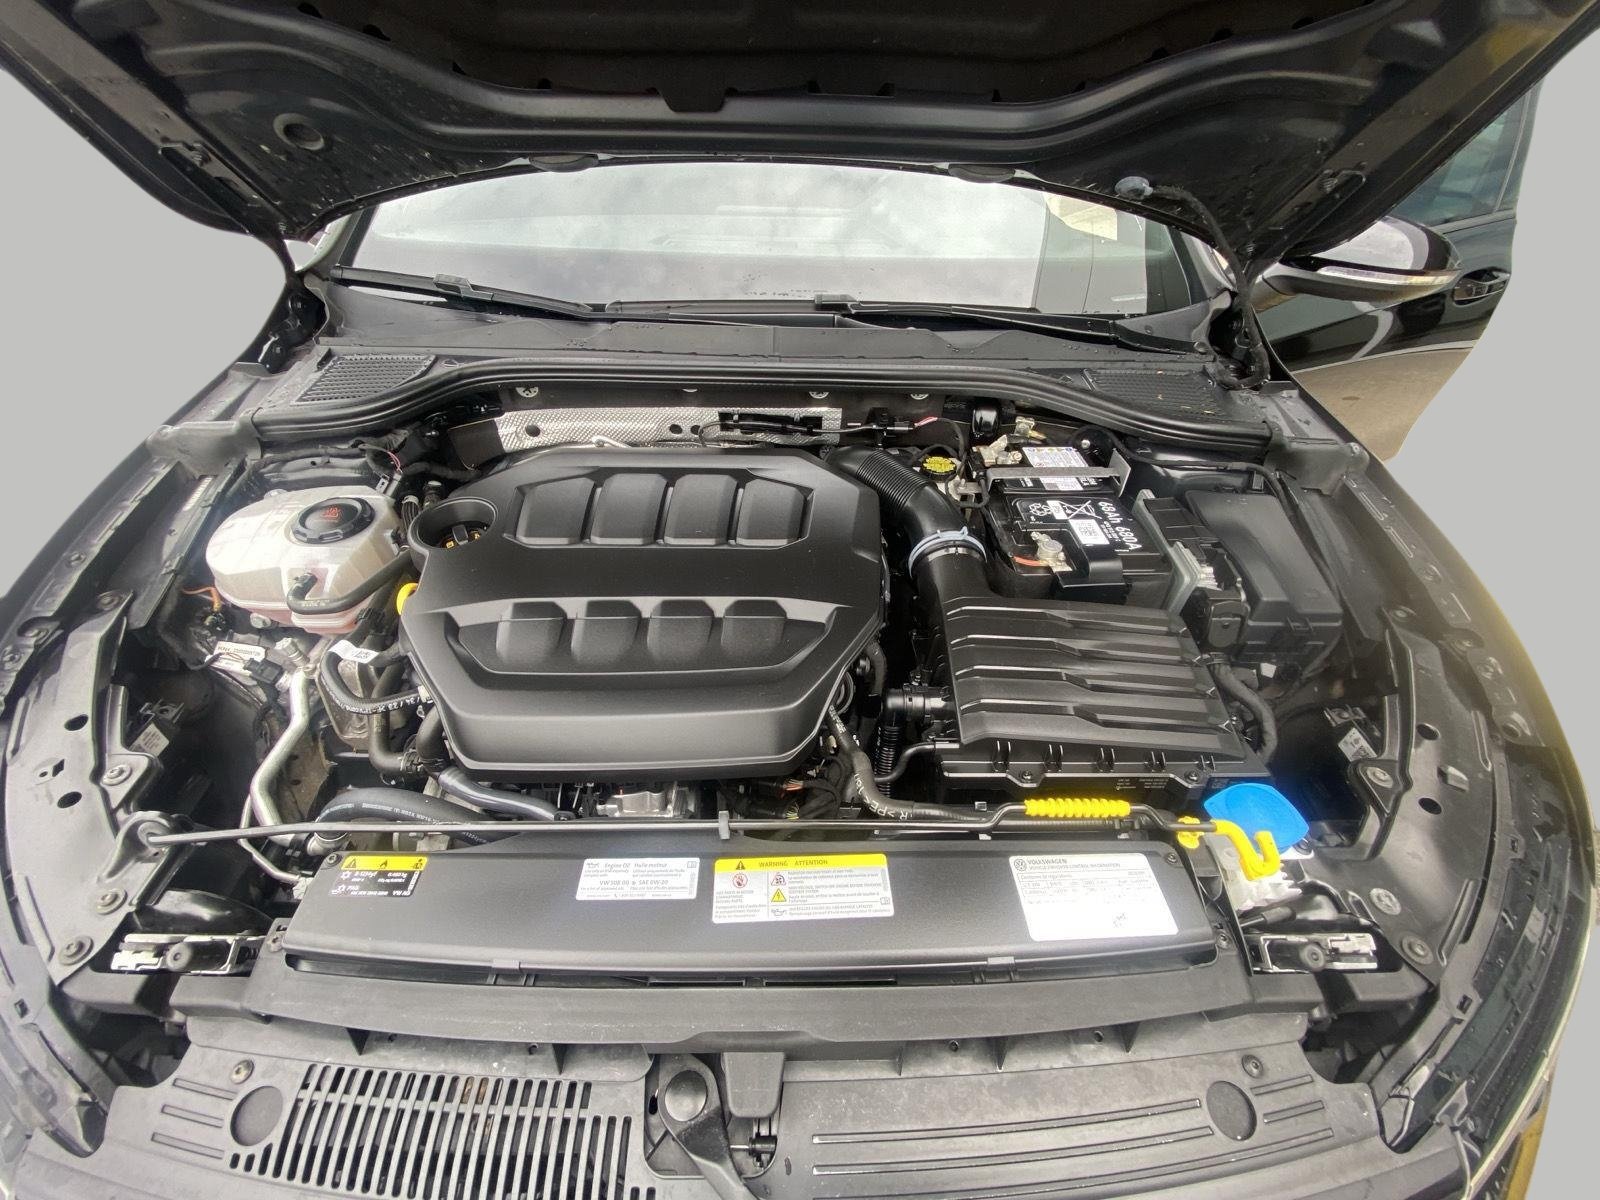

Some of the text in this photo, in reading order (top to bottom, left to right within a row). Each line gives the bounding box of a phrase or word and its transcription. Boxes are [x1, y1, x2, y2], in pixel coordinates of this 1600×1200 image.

[1098, 501, 1123, 523] 68Ah
[1115, 526, 1142, 550] 680A
[604, 862, 622, 870] Engine
[758, 860, 788, 868] WARNING
